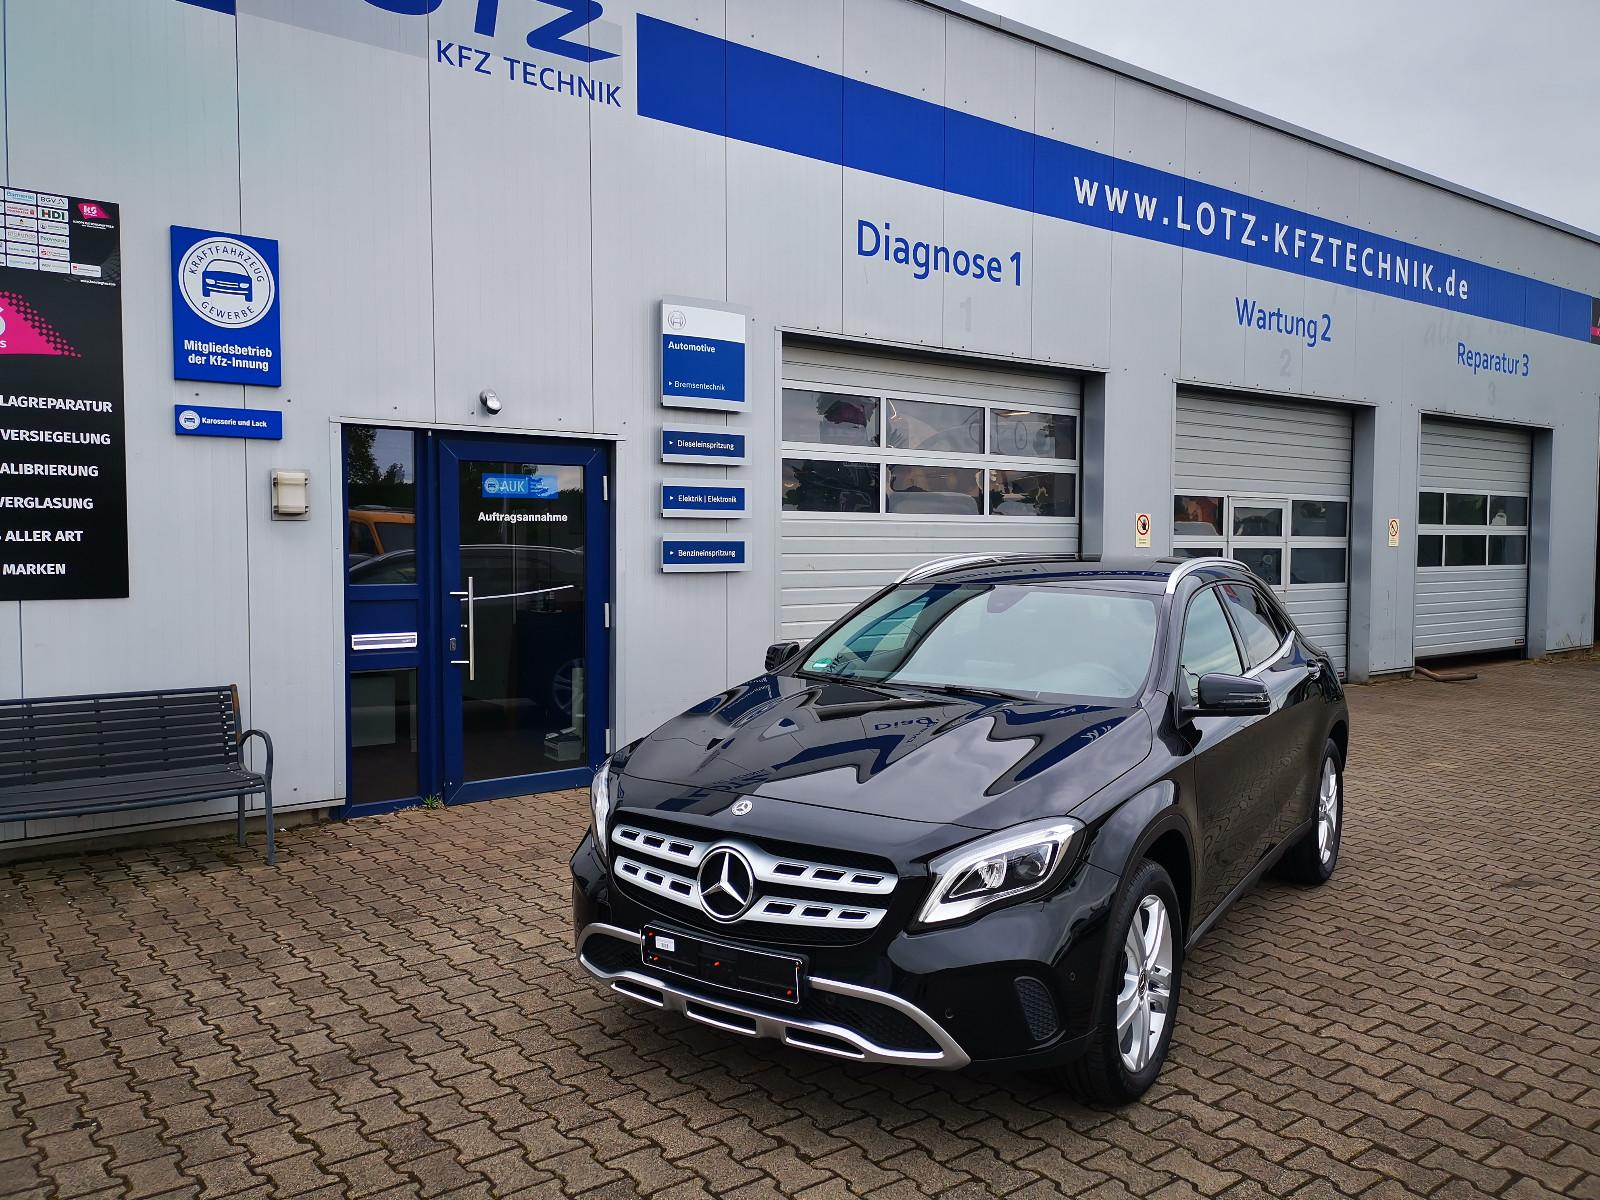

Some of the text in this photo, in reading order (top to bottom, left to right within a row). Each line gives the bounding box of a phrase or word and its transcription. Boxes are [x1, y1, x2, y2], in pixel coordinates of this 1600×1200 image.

[436, 39, 622, 107] KFZ TECHNIK
[42, 209, 65, 221] HDI
[1073, 175, 1469, 300] www.LOTZ-KFZTECHNIK.de
[857, 219, 1021, 286] Diagnose 1
[189, 244, 265, 283] KRAFTFAHRZEUG
[201, 301, 255, 320] GEWERBE
[1235, 296, 1332, 348] Wartung 2
[184, 339, 273, 358] Mitgliedsbetrieb
[668, 341, 716, 353] Automotive
[188, 353, 269, 372] der Kfz-Innung
[1456, 342, 1530, 377] Reparatur 3
[674, 381, 726, 391] Bremsentechnik
[201, 417, 267, 428] Karosserie und Lack
[0, 429, 111, 445] VERSIEGELUNG
[677, 439, 735, 451] Dieseleinspritzung
[0, 463, 99, 477] ALIBRIERUNG
[678, 494, 737, 503] Elektrik Elektronik
[478, 511, 568, 524] Auftragsannahme
[5, 530, 52, 542] ALLER
[54, 530, 84, 542] ART
[678, 549, 736, 558] Benzineinspritzung
[2, 563, 66, 575] MARKEN
